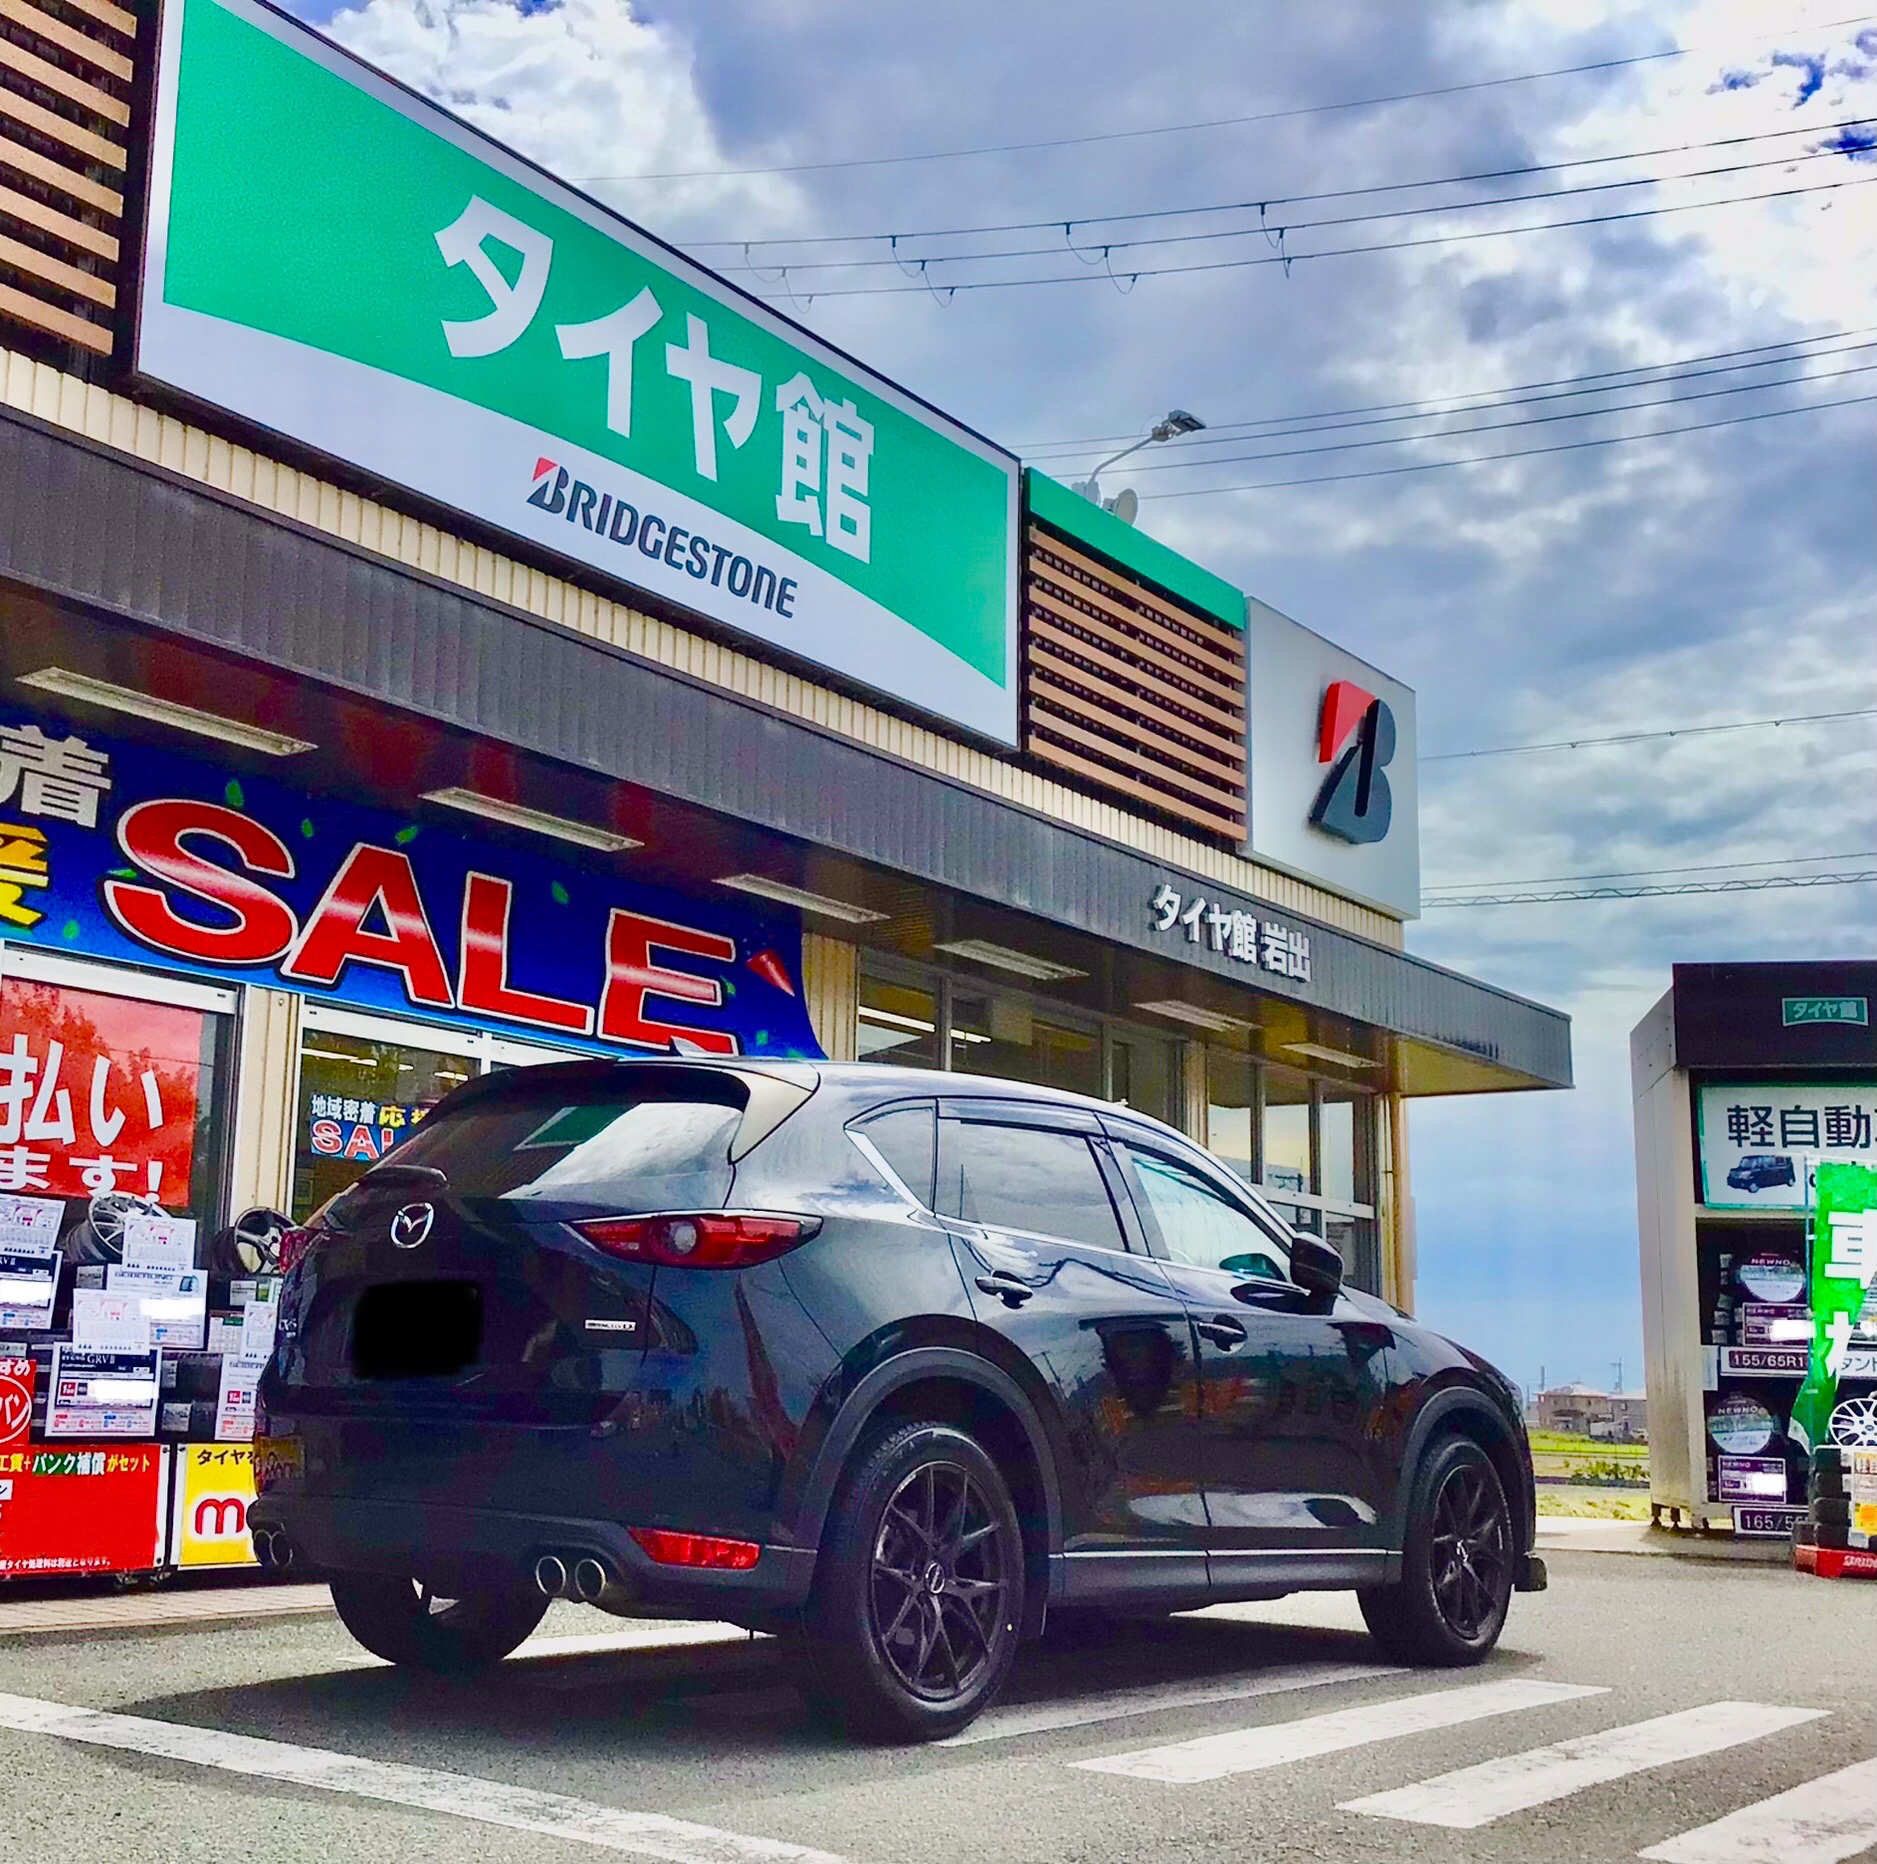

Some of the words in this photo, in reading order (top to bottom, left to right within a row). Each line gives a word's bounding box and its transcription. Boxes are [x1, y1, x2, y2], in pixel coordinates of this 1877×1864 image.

[433, 194, 875, 565] タイヤ館
[526, 456, 798, 620] BRIDGESTONE
[103, 798, 739, 1056] SALE
[1152, 883, 1259, 965] タイヤ館
[1260, 920, 1312, 984] 岩出
[1792, 1001, 1859, 1019] タイヤ館
[1727, 1105, 1877, 1149] 軽自動
